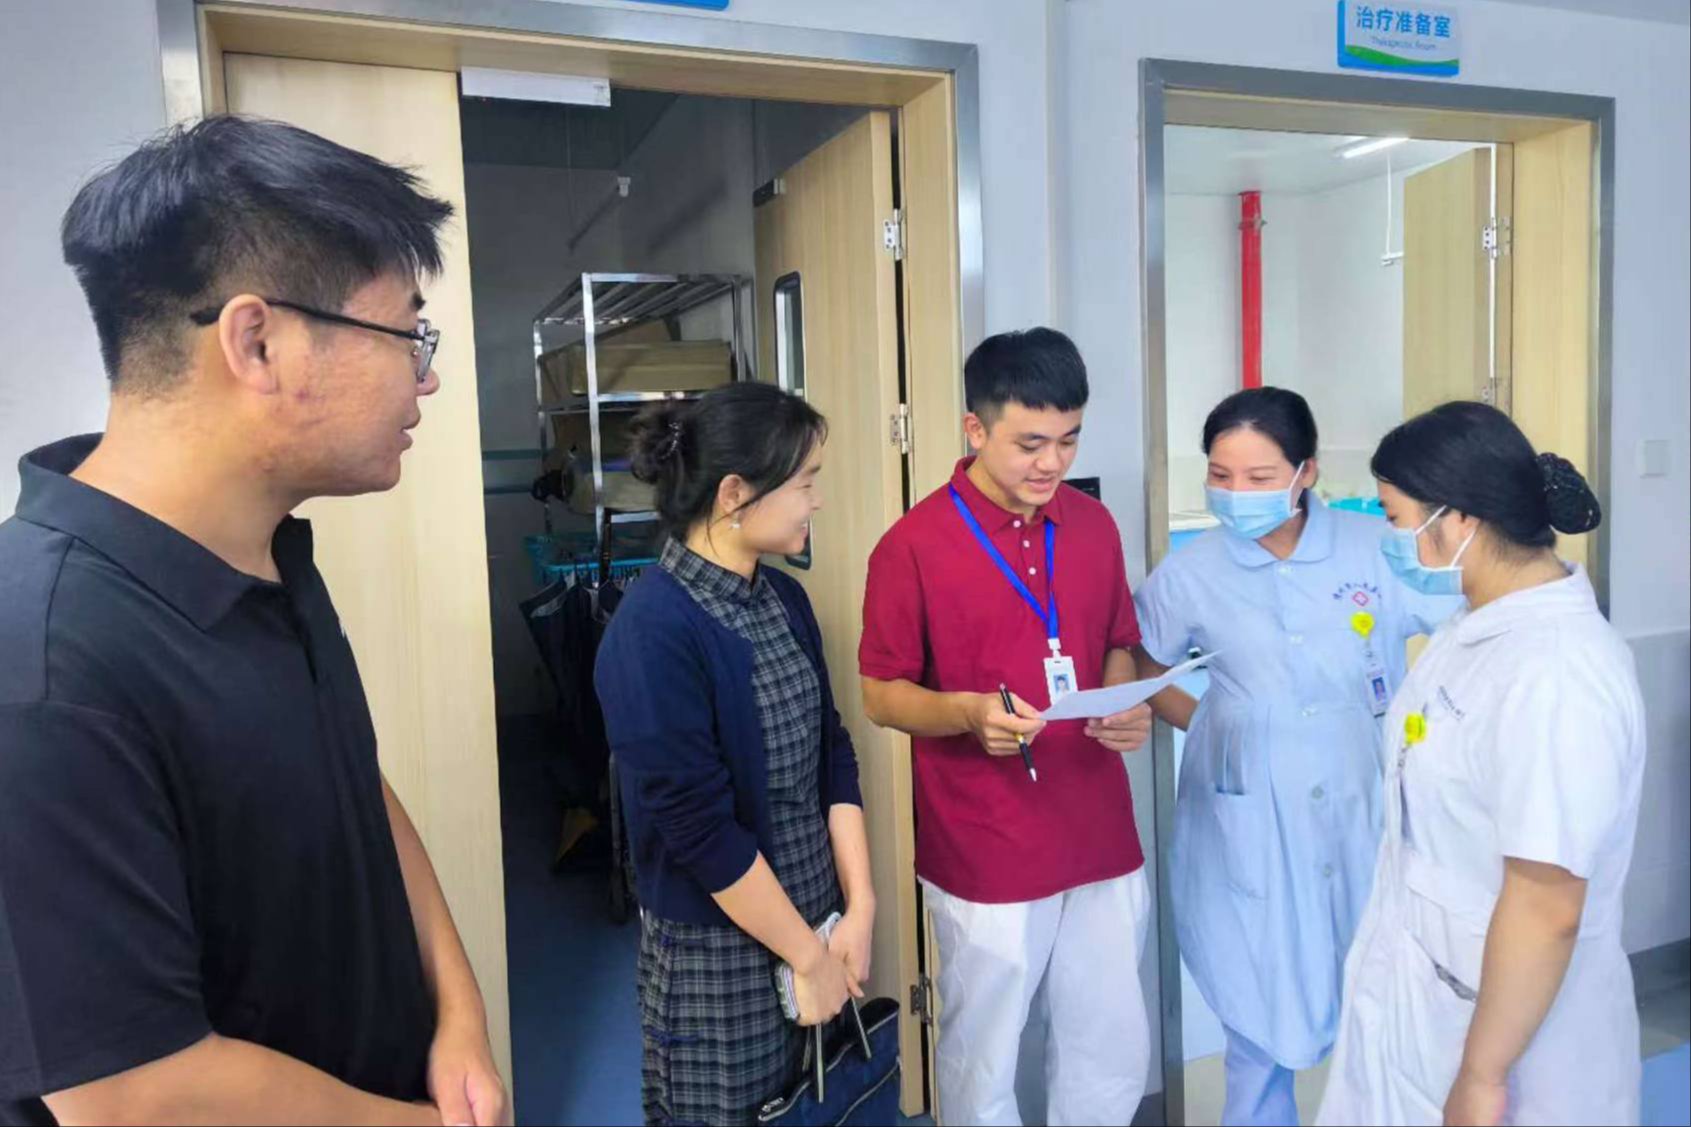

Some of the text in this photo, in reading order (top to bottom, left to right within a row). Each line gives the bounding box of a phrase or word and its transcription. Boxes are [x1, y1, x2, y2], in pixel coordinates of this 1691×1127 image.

[1357, 6, 1450, 38] 治疗准备室
